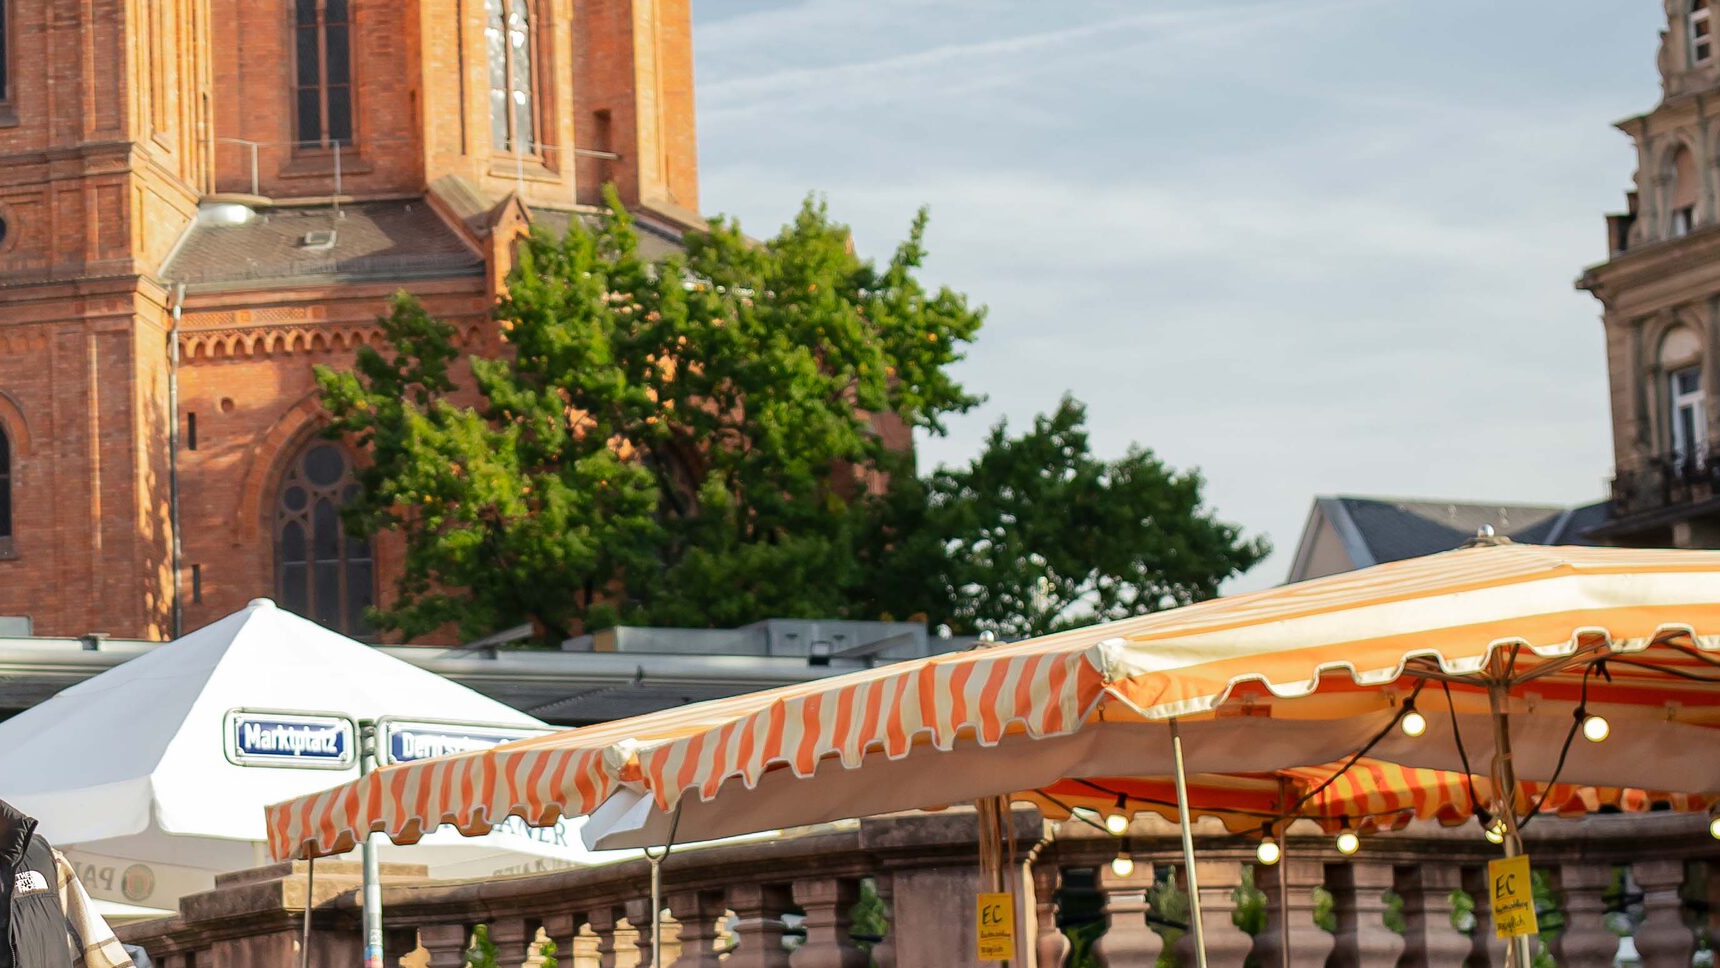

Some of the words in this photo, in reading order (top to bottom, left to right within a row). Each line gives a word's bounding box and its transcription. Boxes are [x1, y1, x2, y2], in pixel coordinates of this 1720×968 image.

[244, 721, 338, 756] Marktplatz
[1495, 873, 1516, 899] EC
[982, 904, 1002, 925] EC
